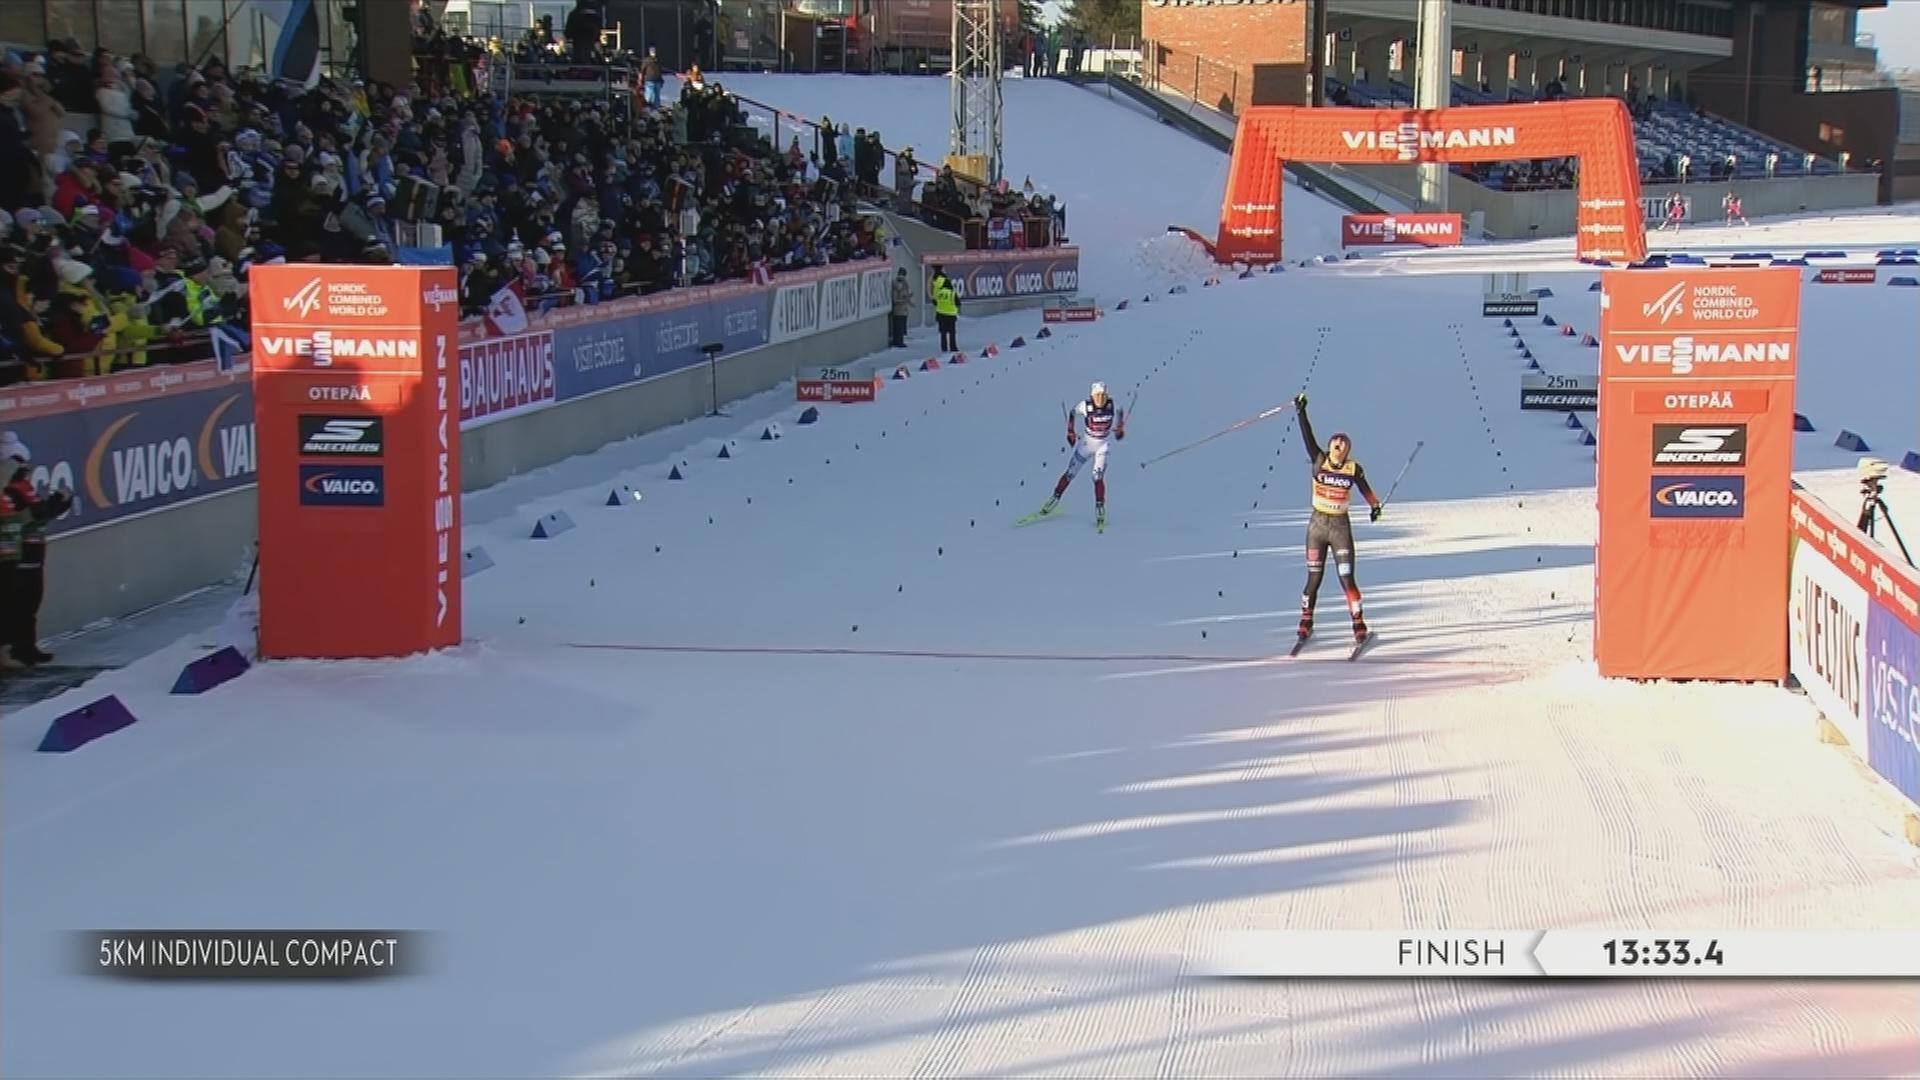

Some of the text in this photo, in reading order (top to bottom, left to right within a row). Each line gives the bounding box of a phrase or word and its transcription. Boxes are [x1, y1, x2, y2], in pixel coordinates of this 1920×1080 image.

[1342, 122, 1515, 160] VIESSMANN
[1350, 216, 1453, 243] VIESSMANN
[328, 283, 367, 294] NORDIC
[1694, 286, 1737, 296] NORDIC
[328, 295, 382, 305] COMBINED
[1693, 297, 1753, 308] COMBINED
[329, 305, 388, 316] WORLD CUP
[1693, 308, 1759, 320] WORLD CUP
[261, 330, 417, 366] VIESSMANN
[1615, 336, 1790, 375] VIESSMANN
[460, 343, 553, 409] BAUHAUS
[820, 368, 850, 381] 25m
[1547, 375, 1578, 389] 25m
[309, 385, 371, 401] OTEPÄÄ
[800, 383, 870, 400] VIESSMANN
[1664, 391, 1734, 408] OTEPÄÄ
[303, 442, 380, 452] SKECHERS
[1655, 452, 1742, 463] SKECHERS
[112, 436, 193, 505] VAICO
[435, 335, 453, 628] VIESSMANN
[1804, 574, 1860, 720] VELTINS
